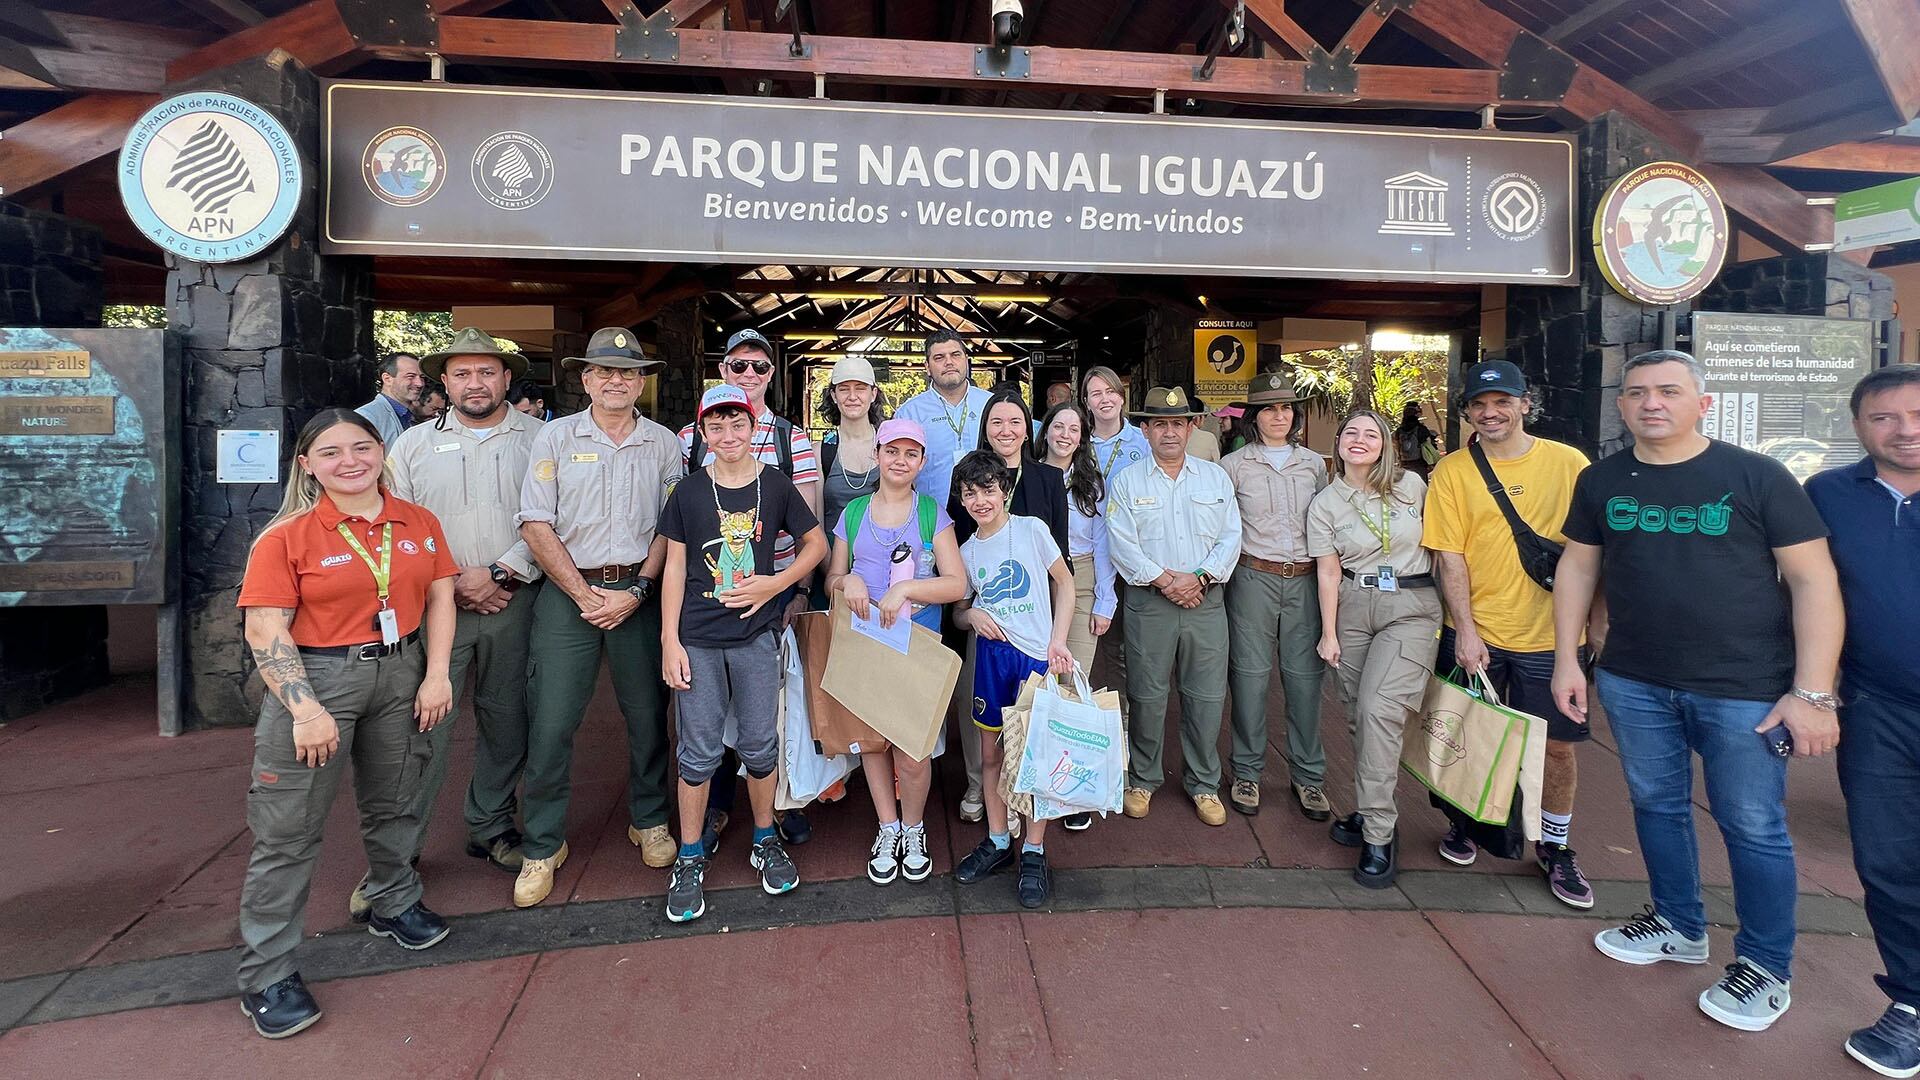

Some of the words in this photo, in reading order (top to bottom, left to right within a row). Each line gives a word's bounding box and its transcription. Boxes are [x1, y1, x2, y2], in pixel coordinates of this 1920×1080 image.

[126, 101, 186, 176] ADMINISTRACIÓN
[188, 99, 203, 108] de
[205, 98, 259, 121] PARQUES
[258, 119, 295, 184] NACIONALES
[619, 133, 840, 189] PARQUE
[858, 143, 1122, 194] NACIONAL
[1138, 151, 1325, 201] IGUAZÚ
[1622, 170, 1650, 194] PARQUE
[1650, 167, 1687, 179] NACIONAL
[502, 188, 522, 197] APN
[489, 196, 535, 207] ARGENTINA
[1388, 189, 1445, 222] UNESCO
[703, 192, 890, 225] Bienvenidos
[916, 199, 1054, 230] Welcome
[1078, 205, 1245, 235] Bem-vindos
[187, 216, 234, 235] APN
[153, 227, 267, 256] ARGENTINA
[1198, 320, 1235, 328] CONSULTE
[1705, 340, 1729, 355] Aquí
[1731, 343, 1743, 353] se
[1744, 341, 1800, 353] cometieron
[46, 355, 86, 371] Falls
[1704, 355, 1754, 368] crímenes
[1756, 356, 1770, 368] de
[1772, 357, 1793, 369] lesa
[1796, 357, 1855, 369] humanidad
[1704, 370, 1739, 382] durante
[1740, 371, 1748, 381] el
[1750, 372, 1795, 383] terrorismo
[1797, 373, 1808, 382] de
[1809, 373, 1838, 383] Estado
[22, 417, 68, 427] NATURE
[1725, 399, 1735, 443] ERDAD
